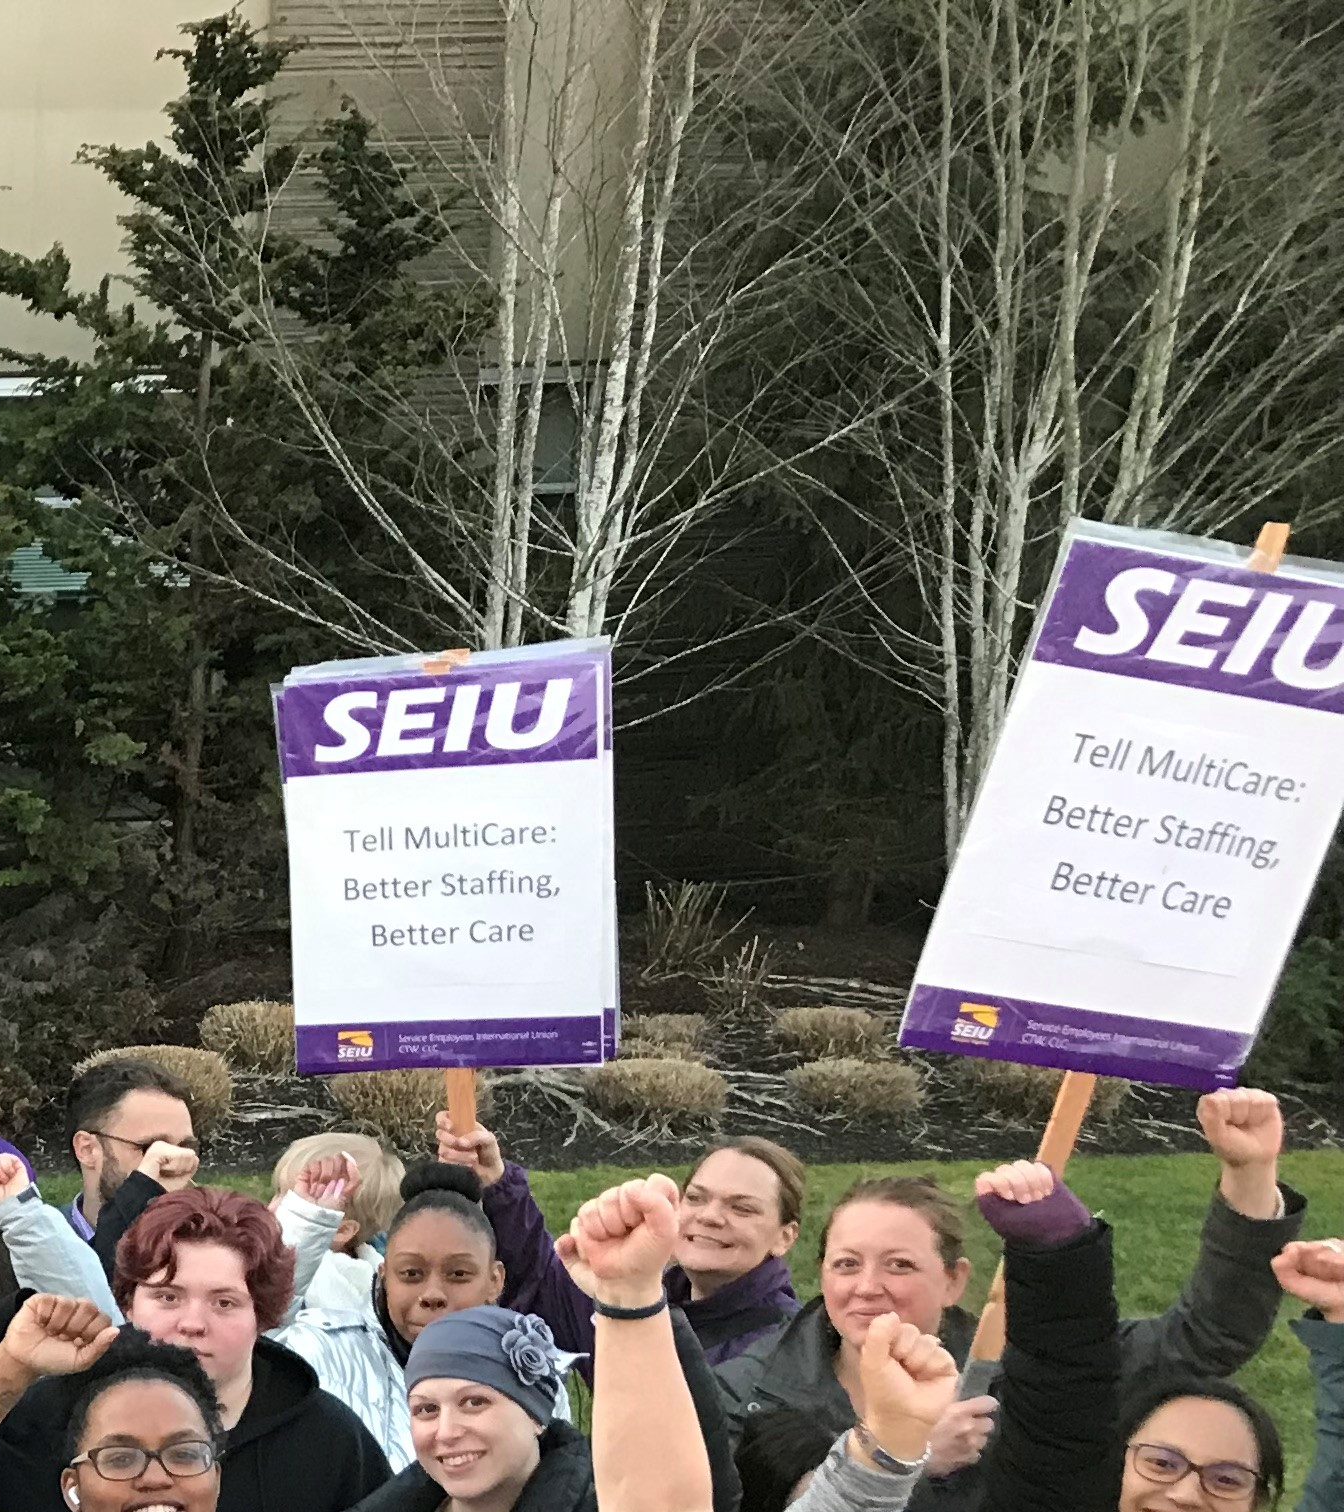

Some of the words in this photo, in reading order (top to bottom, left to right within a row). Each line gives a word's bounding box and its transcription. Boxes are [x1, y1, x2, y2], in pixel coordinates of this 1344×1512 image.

[1073, 567, 1344, 692] SEIU
[314, 677, 573, 763] SEIU
[1071, 732, 1134, 772] Tell
[1136, 745, 1308, 804] MultiCare:
[343, 827, 394, 854] Tell
[404, 822, 557, 851] MultiCare:
[1041, 794, 1151, 842] Better
[1152, 814, 1282, 871] Staffing,
[343, 875, 432, 902] Better
[440, 870, 561, 899] Staffing,
[1050, 861, 1156, 908] Better
[1160, 880, 1232, 920] Care
[371, 922, 461, 948] Better
[469, 919, 535, 945] Care
[337, 1046, 374, 1059] SEIU
[950, 1023, 994, 1040] SEIU
